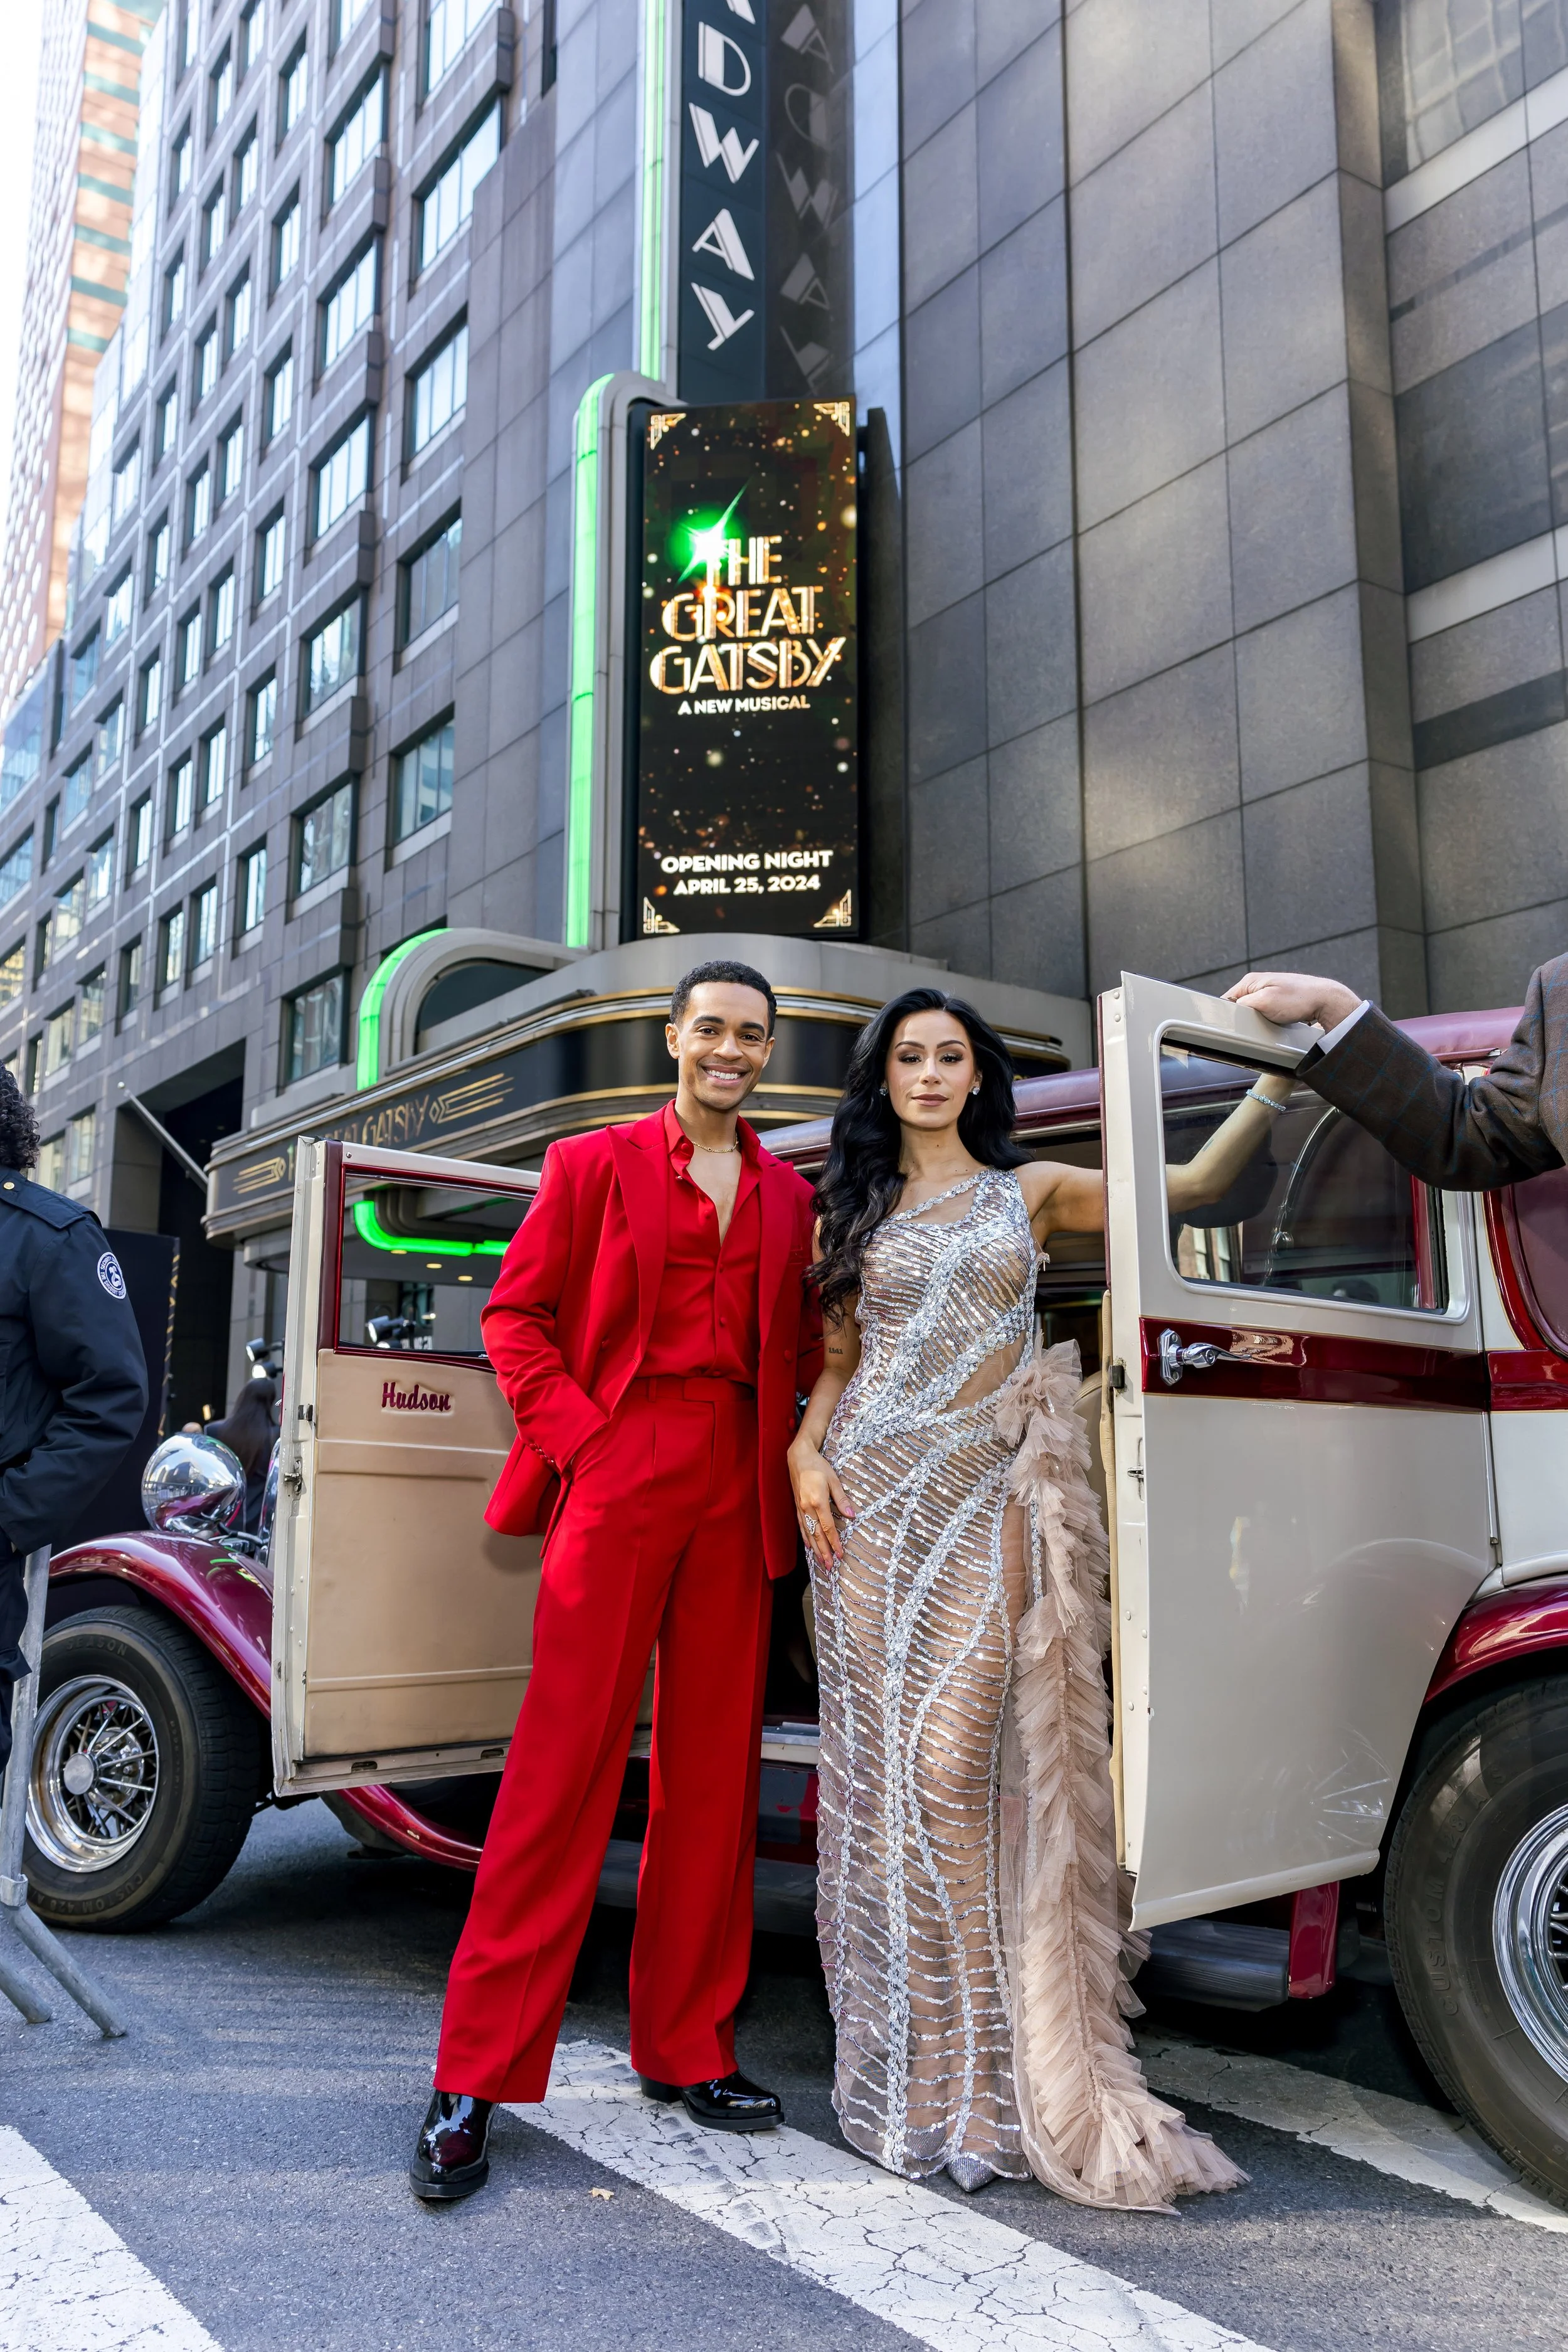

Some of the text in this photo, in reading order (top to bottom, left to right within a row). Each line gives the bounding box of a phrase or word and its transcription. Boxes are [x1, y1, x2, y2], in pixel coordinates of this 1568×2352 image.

[662, 585, 824, 641] GREAT
[649, 636, 846, 694] GATSBY
[677, 694, 811, 716] A NEW MUSICAL
[660, 849, 834, 874] OPENING NIGHT
[673, 874, 821, 896] APRIL 25, 2024
[381, 1381, 452, 1411] Hudson
[66, 1636, 128, 1656] SEASON
[82, 1872, 143, 1914] CUSTOM
[1424, 1876, 1459, 2016] CUSTOM
